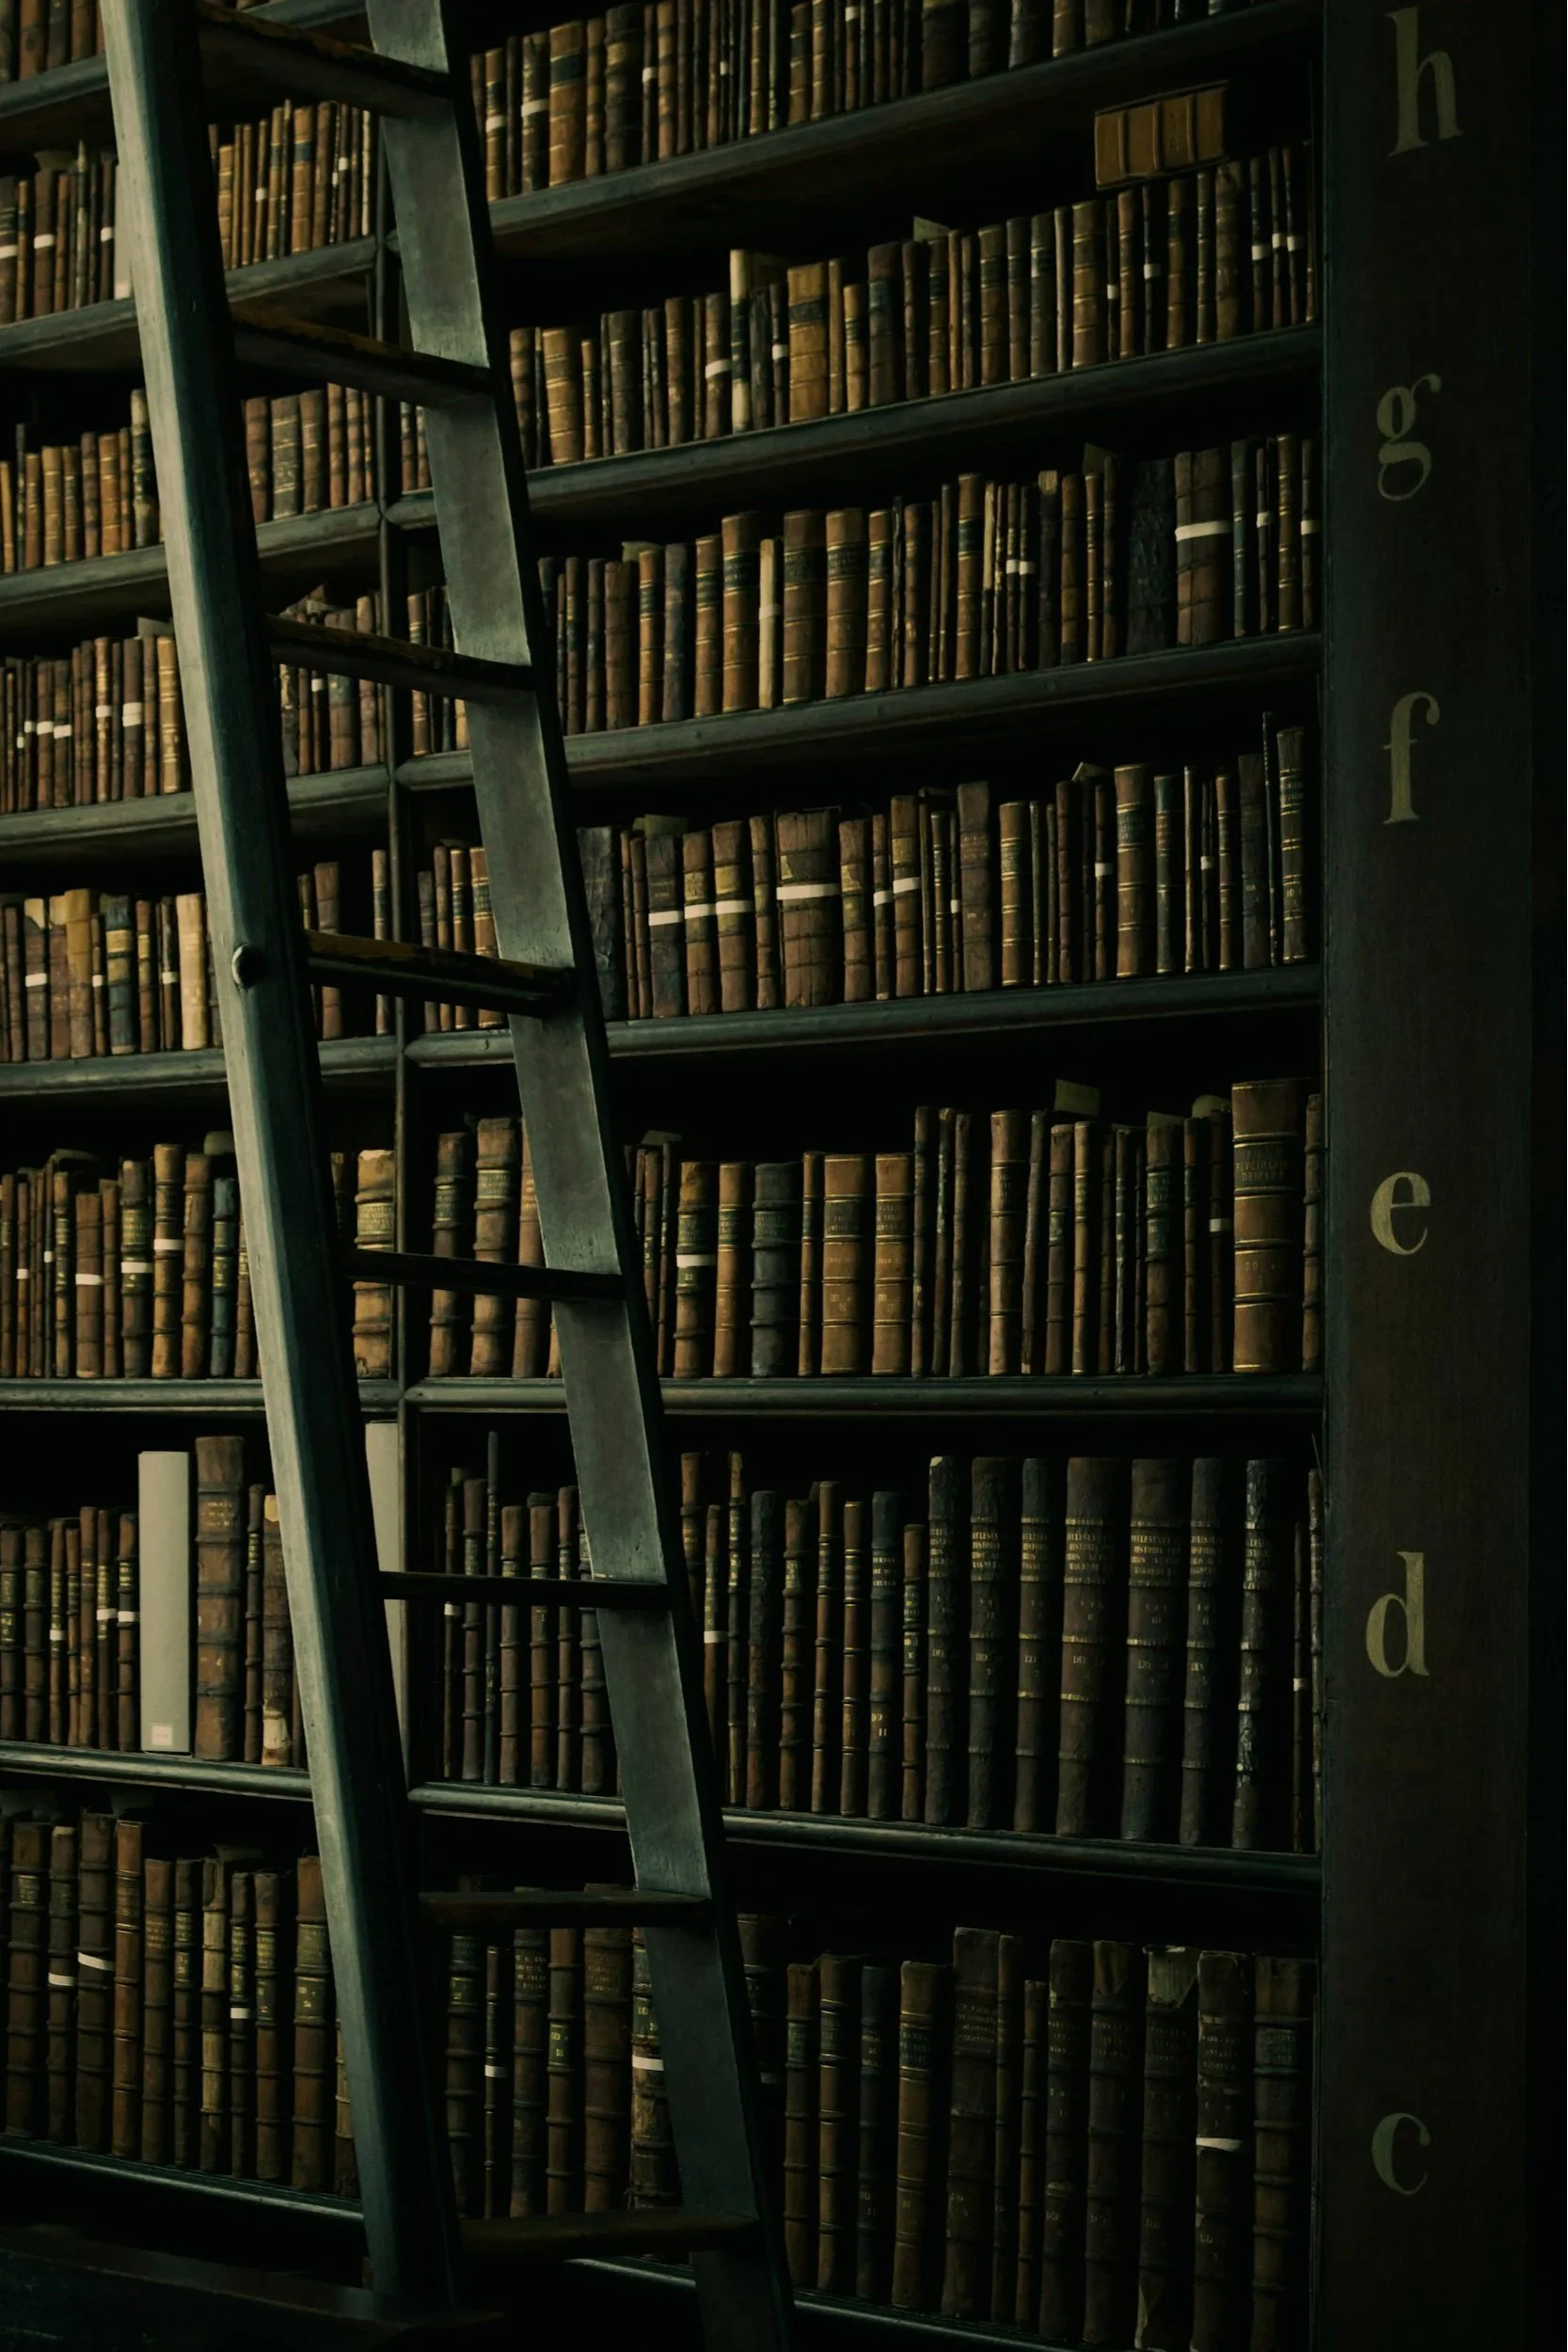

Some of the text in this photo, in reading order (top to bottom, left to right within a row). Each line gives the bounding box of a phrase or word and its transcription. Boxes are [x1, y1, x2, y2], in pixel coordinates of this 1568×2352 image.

[1385, 6, 1461, 156] h
[1375, 373, 1442, 501] g
[1383, 691, 1440, 825] f
[1370, 1171, 1431, 1256] e
[1365, 1550, 1429, 1677] d
[1370, 2112, 1431, 2196] c
